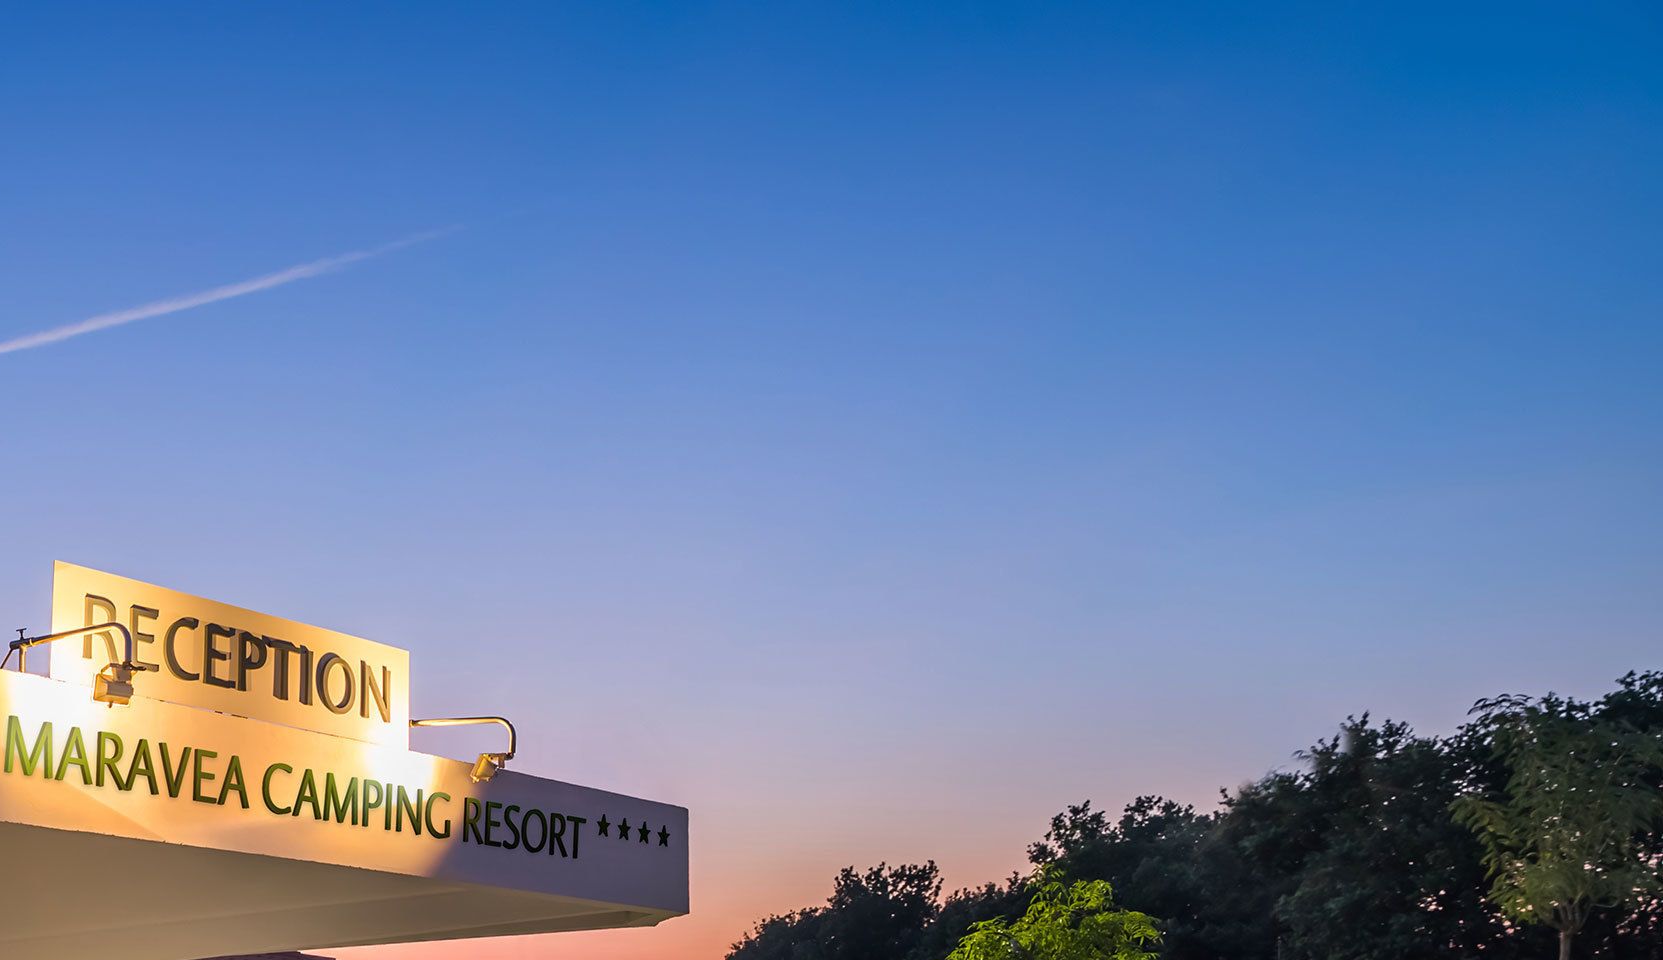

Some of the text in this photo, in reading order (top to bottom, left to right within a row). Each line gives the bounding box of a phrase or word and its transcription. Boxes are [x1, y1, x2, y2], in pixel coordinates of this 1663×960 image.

[82, 593, 392, 723] RECEPTION
[4, 715, 250, 810] MARAVEA
[262, 763, 451, 839] CAMPING
[463, 796, 586, 859] RESORT
